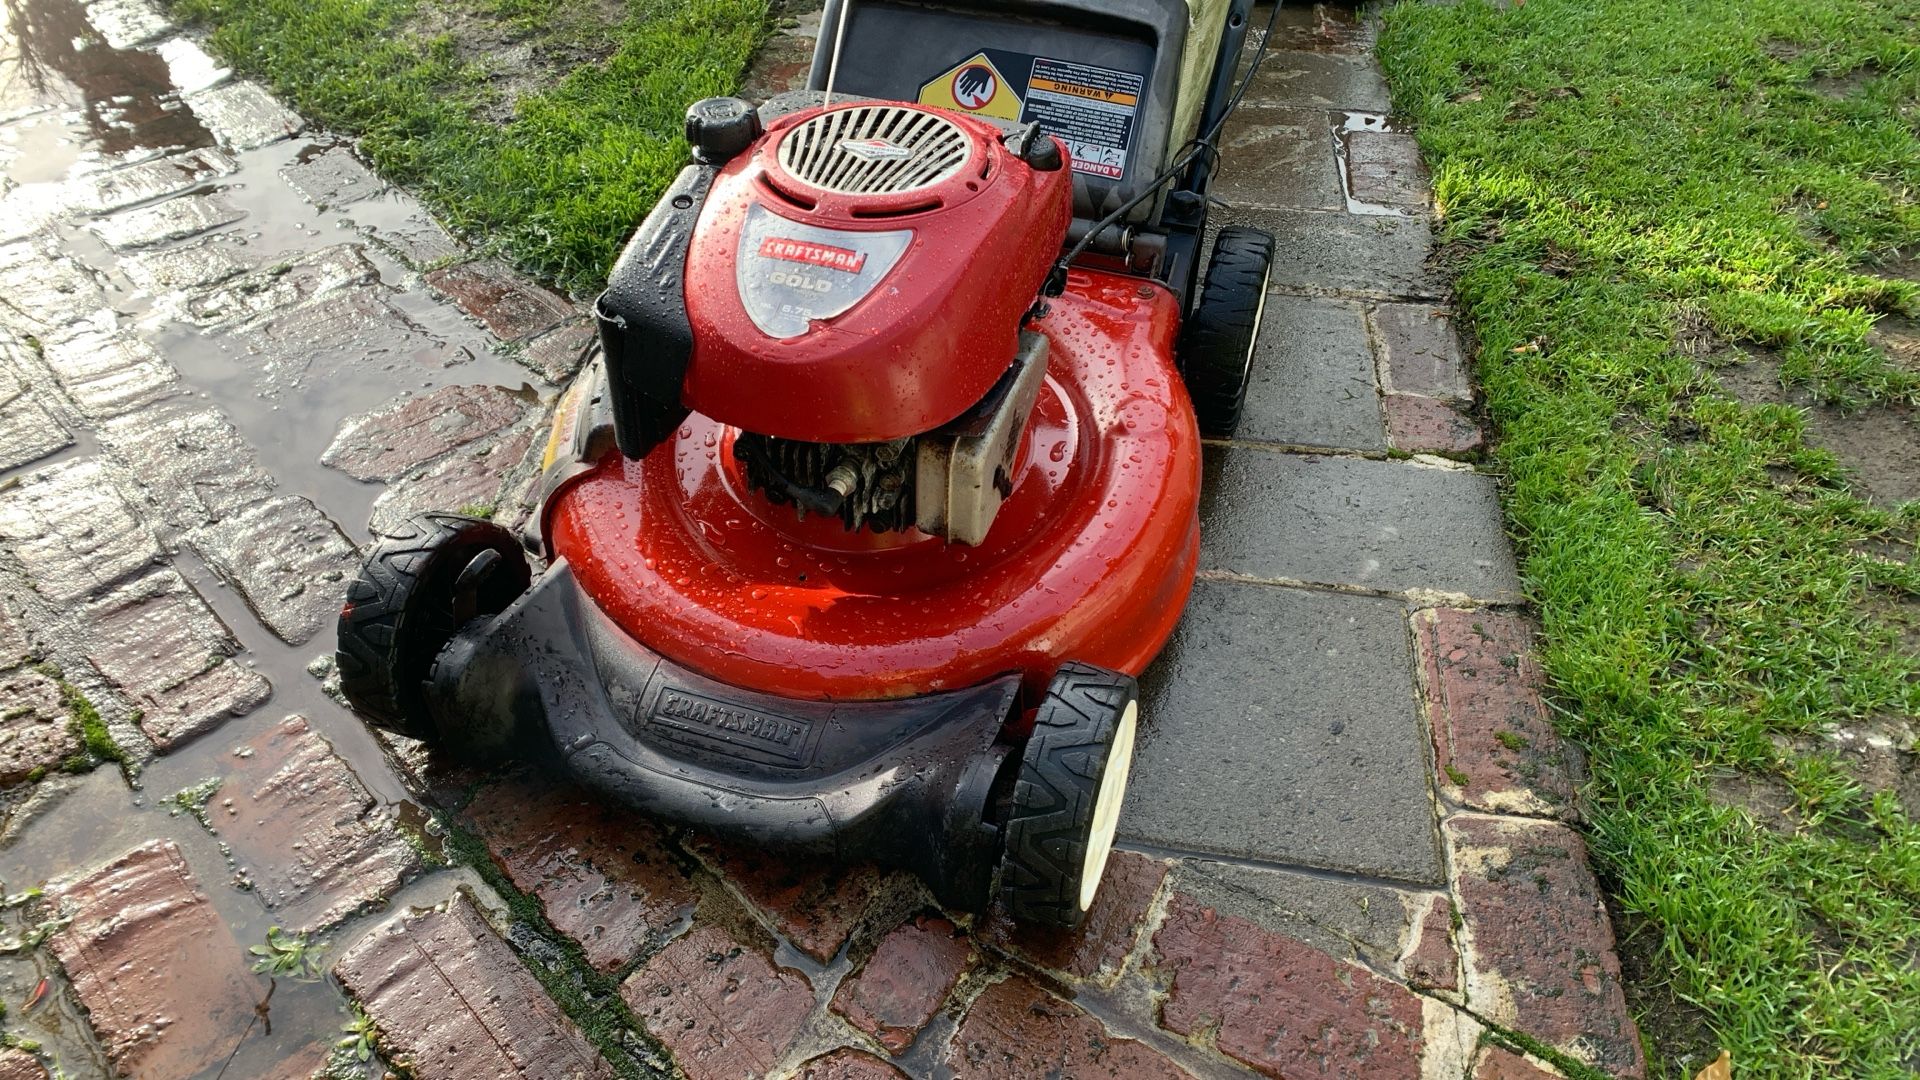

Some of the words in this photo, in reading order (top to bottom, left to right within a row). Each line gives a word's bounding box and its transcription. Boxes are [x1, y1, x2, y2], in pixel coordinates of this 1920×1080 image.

[1053, 83, 1101, 98] WARNING
[1071, 160, 1110, 174] DANGER
[764, 241, 859, 268] CRAFTSMAN
[769, 272, 833, 293] GOLD
[662, 693, 796, 746] CRAFTSMAN
